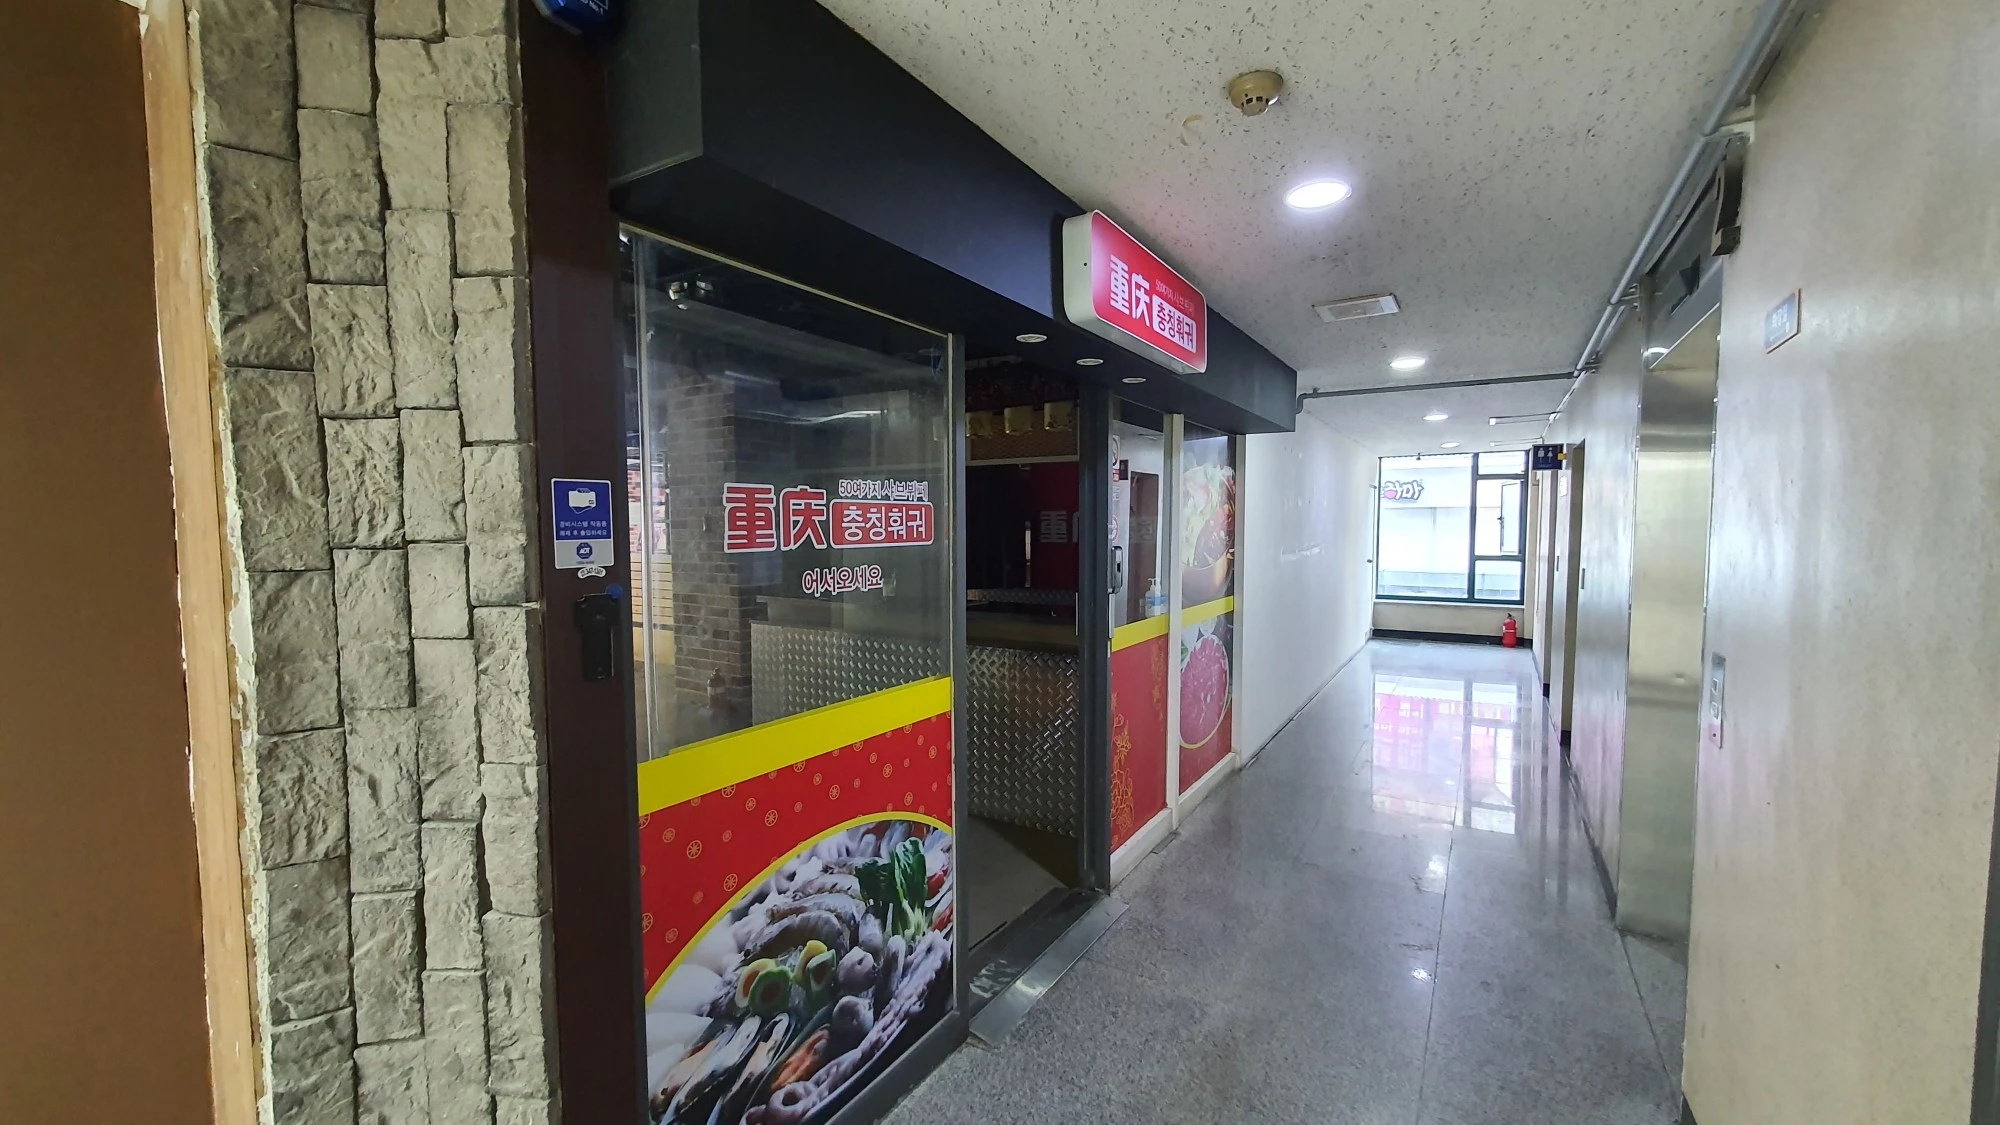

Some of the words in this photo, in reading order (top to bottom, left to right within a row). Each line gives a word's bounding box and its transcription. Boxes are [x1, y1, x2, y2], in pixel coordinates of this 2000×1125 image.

[1109, 253, 1150, 327] 重庆
[1157, 301, 1194, 350] 충칭훠궈
[838, 479, 882, 500] 50여가지
[882, 479, 929, 502] 샤브뷔페
[723, 482, 827, 553] 重庆
[841, 506, 926, 541] 충칭훠궈
[802, 564, 883, 597] 어서오세요
